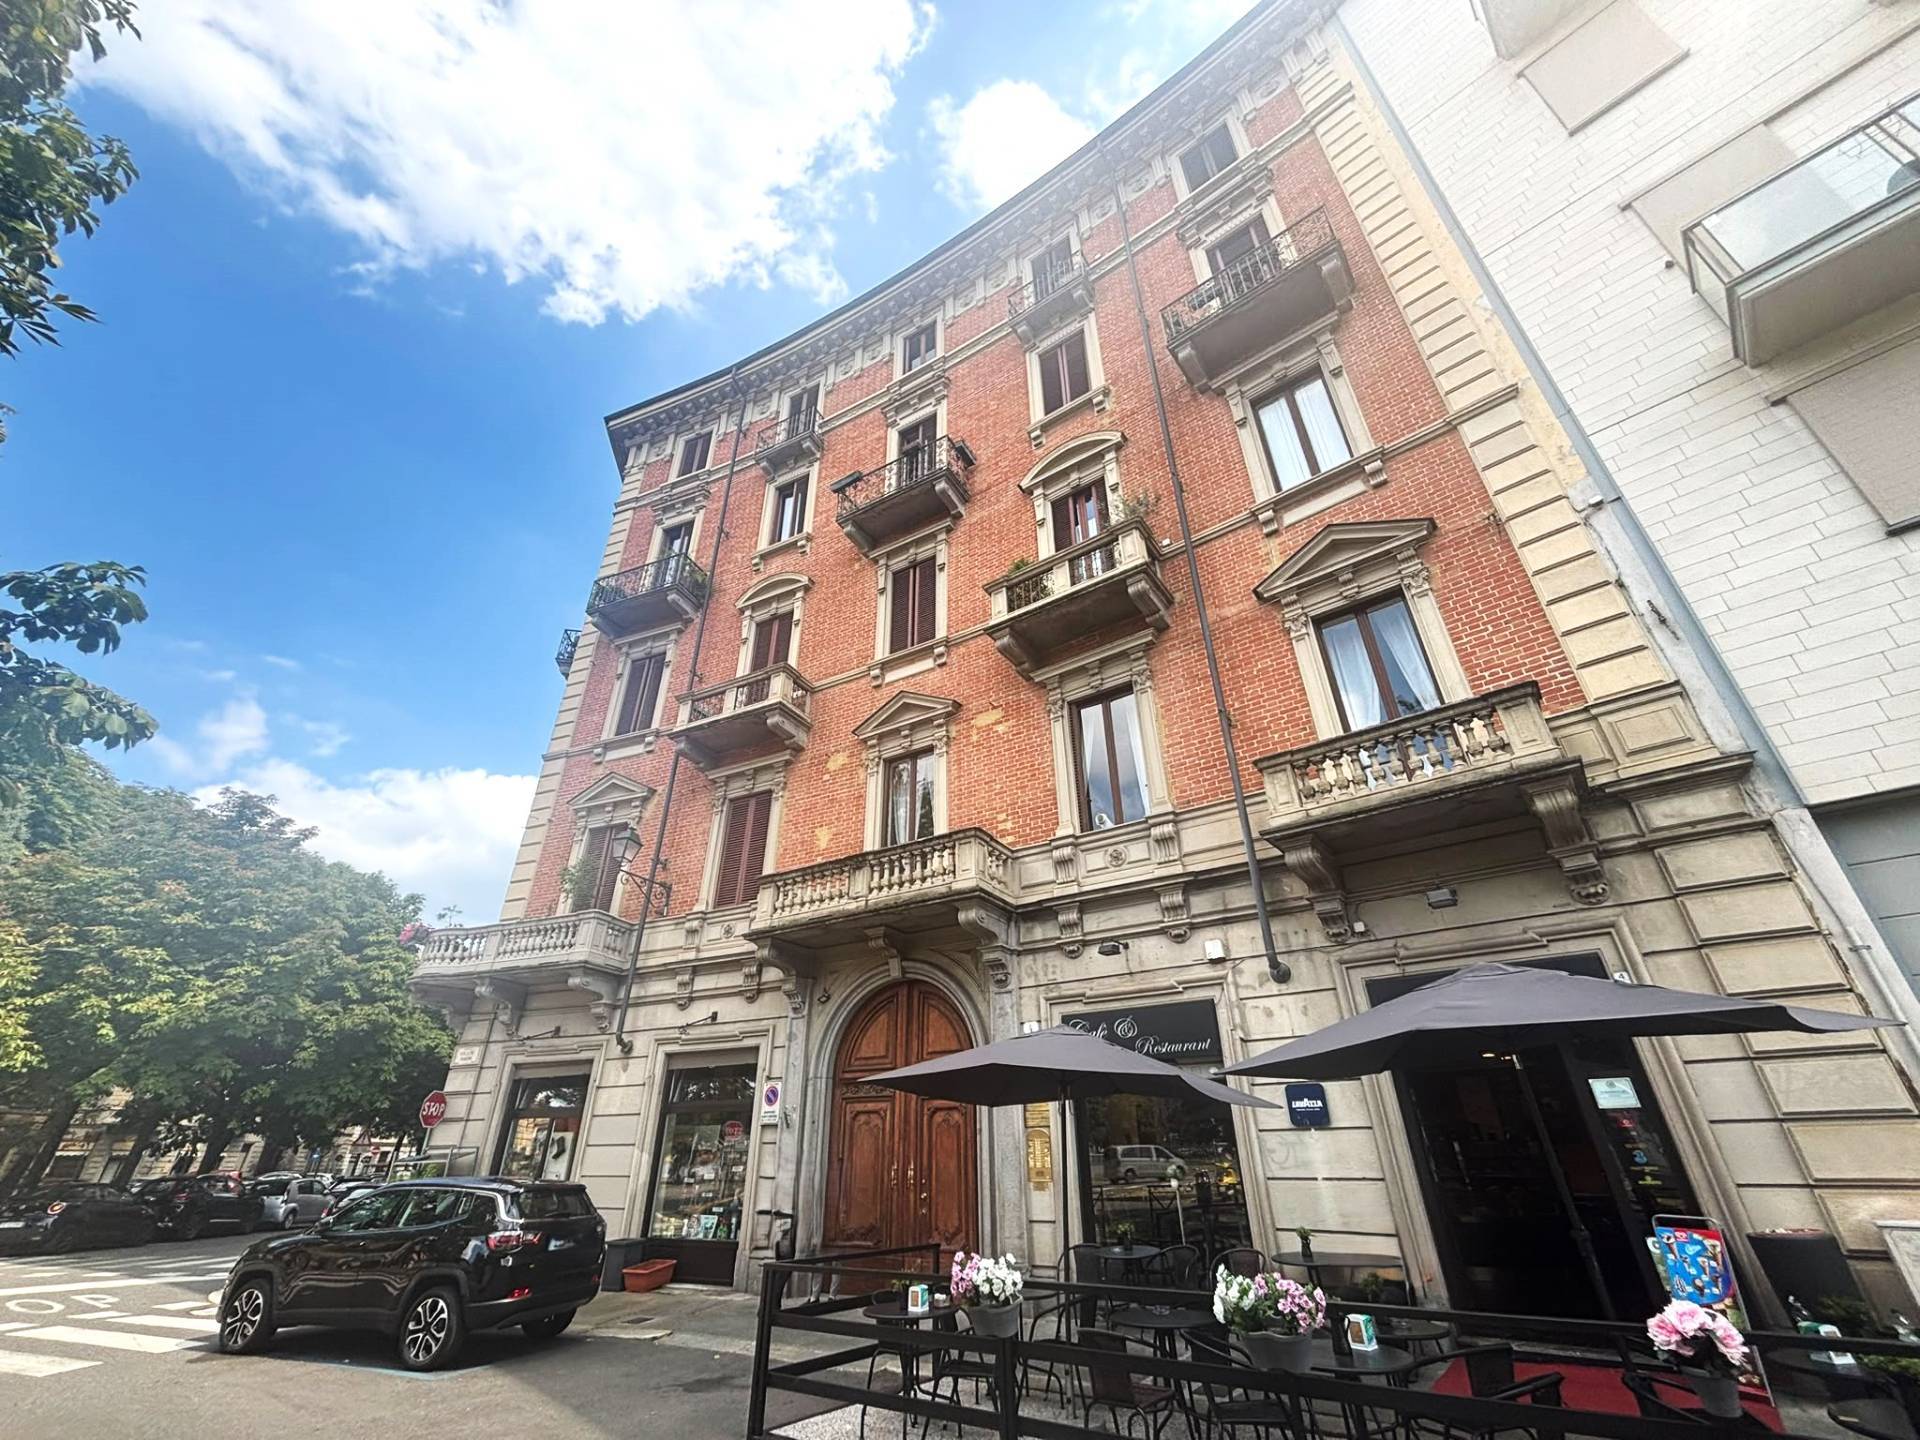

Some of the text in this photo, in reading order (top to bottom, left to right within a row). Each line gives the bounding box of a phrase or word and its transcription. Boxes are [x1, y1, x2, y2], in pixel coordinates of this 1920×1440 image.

[1114, 1016, 1137, 1038] &
[1135, 1035, 1212, 1055] Restaurant
[422, 1101, 445, 1116] STOP
